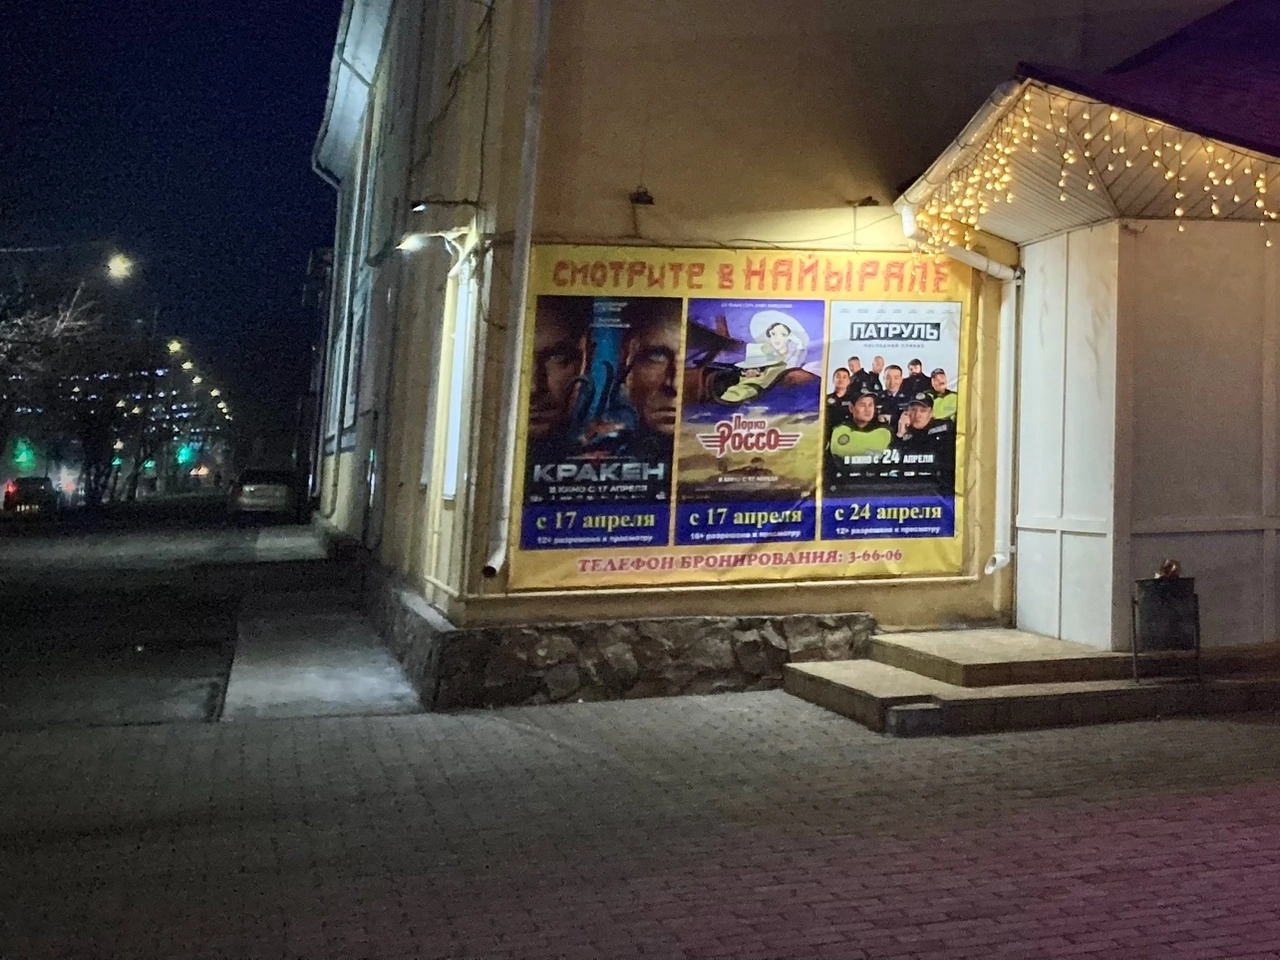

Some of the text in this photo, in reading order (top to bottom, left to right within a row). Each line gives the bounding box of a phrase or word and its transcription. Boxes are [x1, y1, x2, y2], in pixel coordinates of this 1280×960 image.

[852, 323, 939, 340] ПАТРУЛЬ
[733, 414, 767, 432] Порко
[882, 449, 900, 464] 24
[903, 454, 934, 464] АПРЕЛЯ
[533, 462, 665, 482] КРАКЕН
[536, 511, 655, 532] с 17 апреля
[689, 508, 802, 528] с 17 апреля
[834, 503, 942, 523] с 24 апреля
[578, 549, 902, 573] ТЕЛЕФОН БРОНИРОВАНИЯ: 3-66-06
